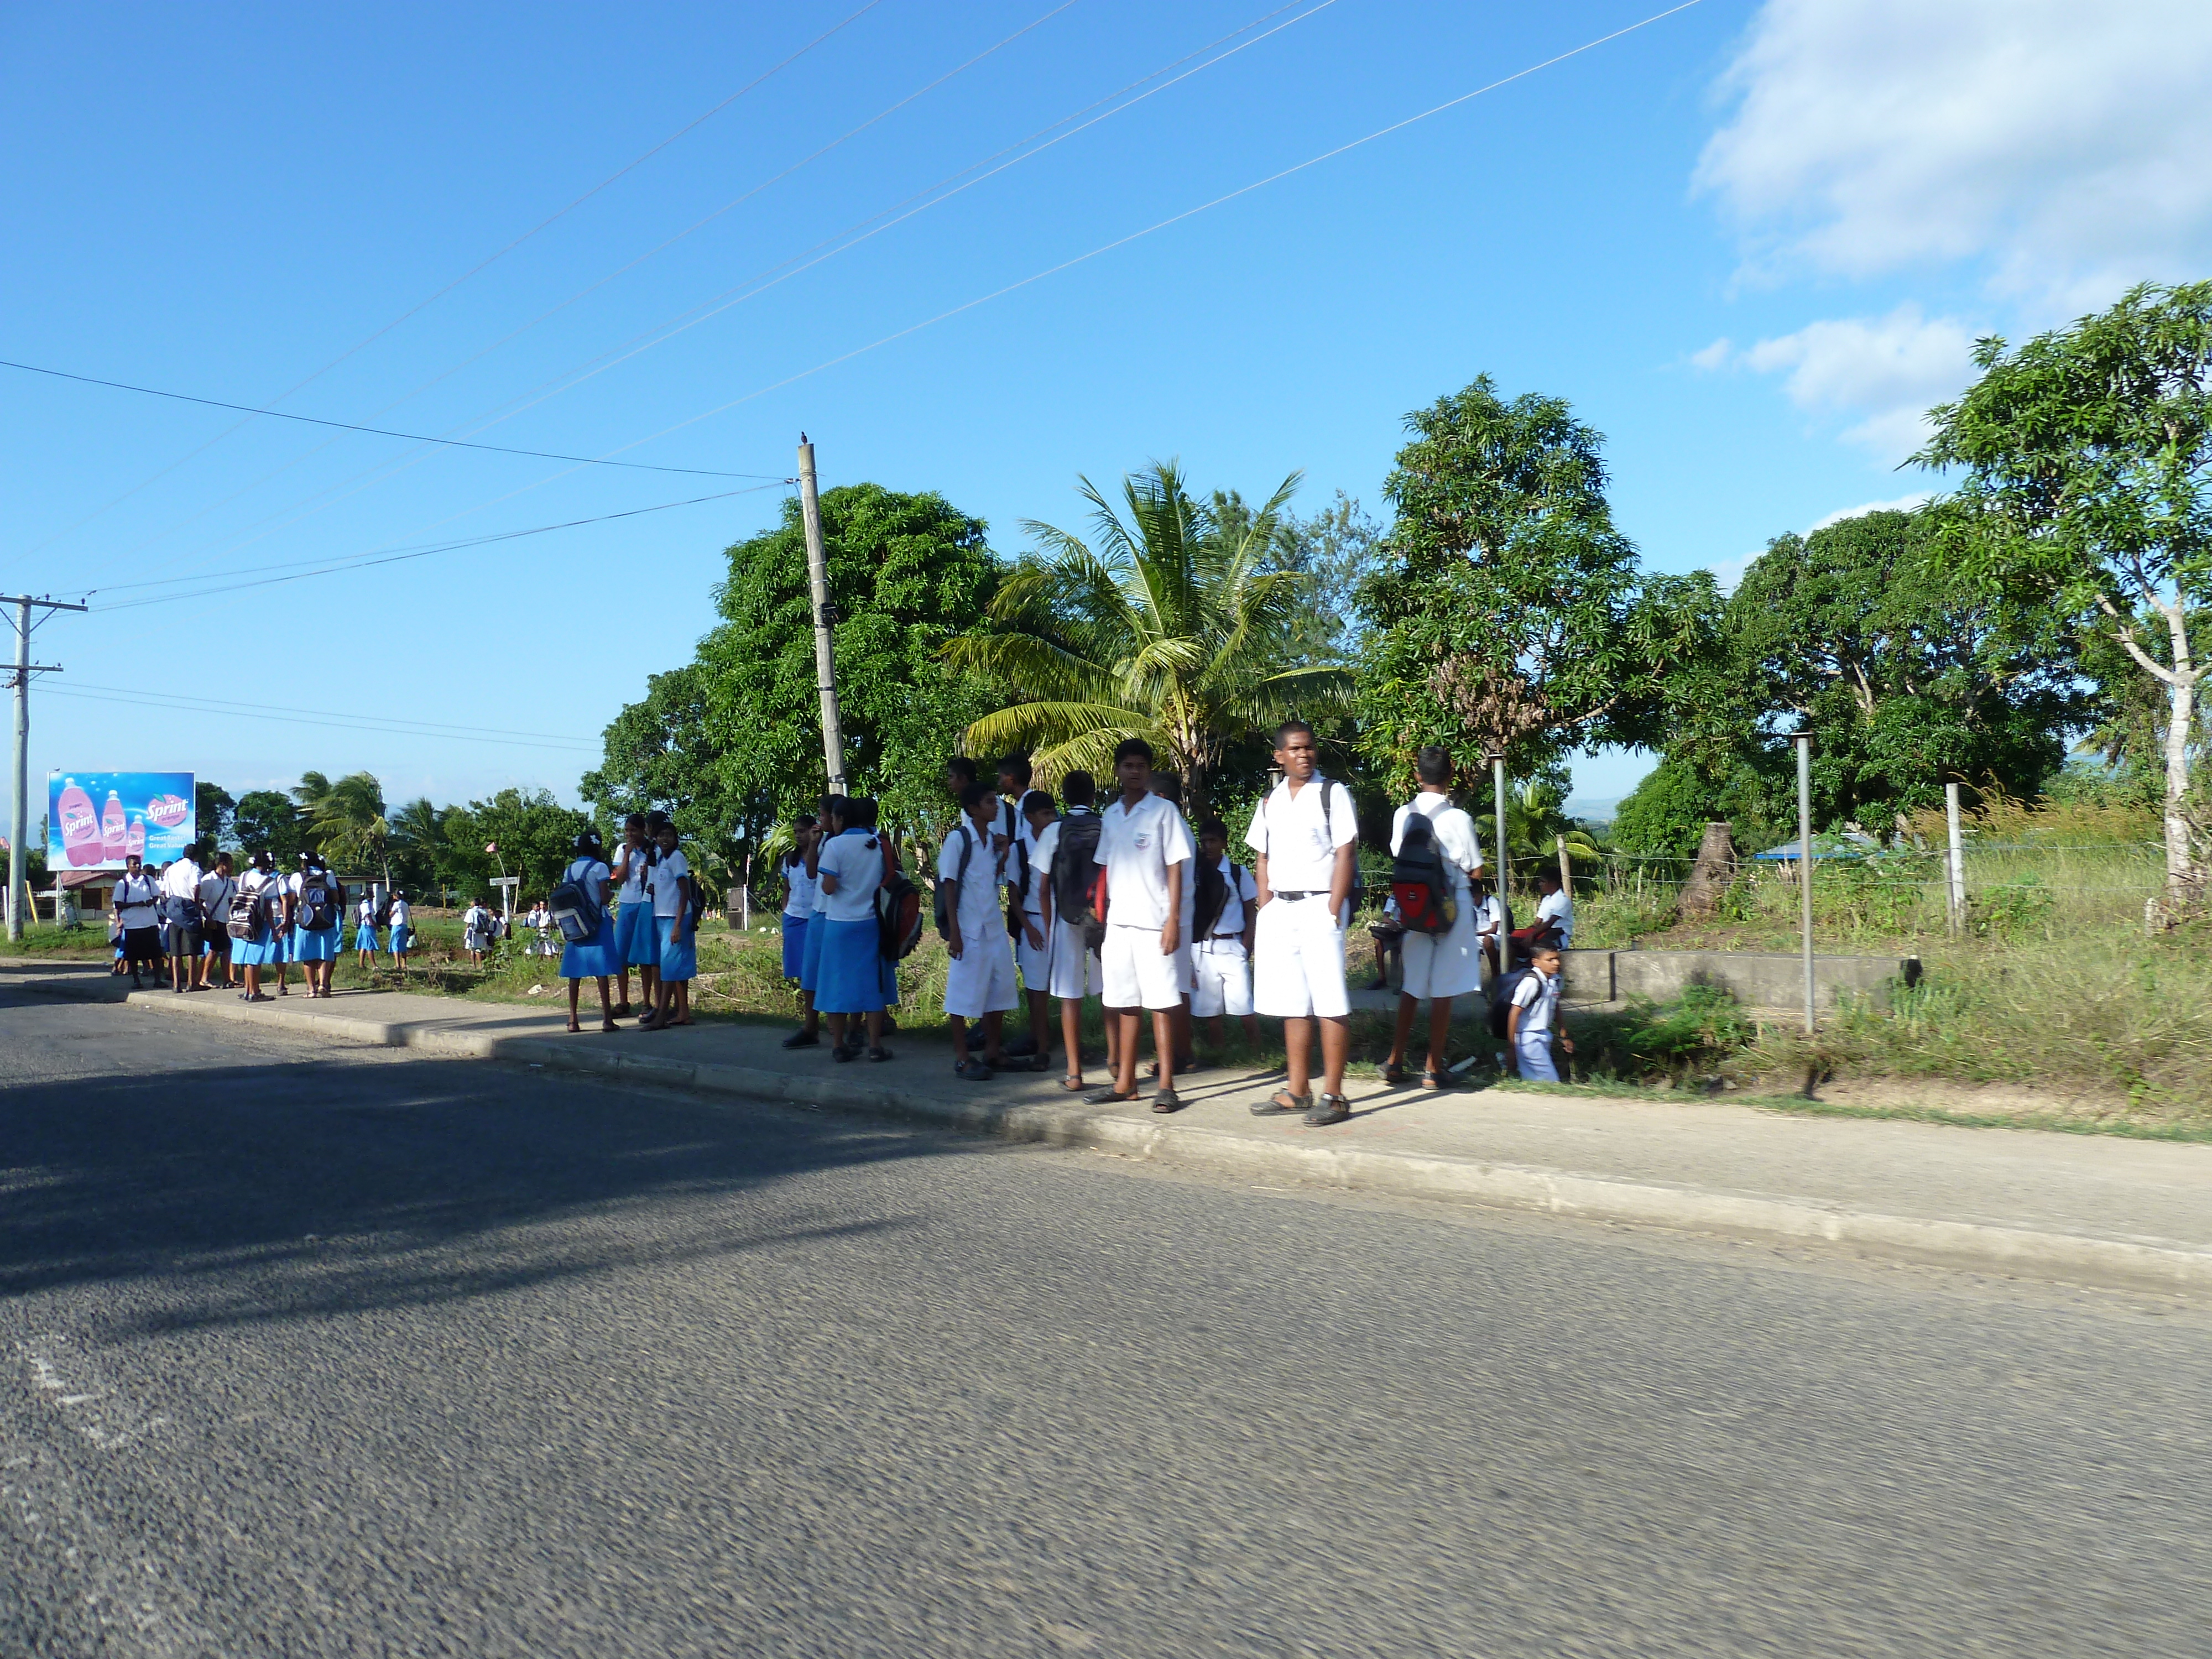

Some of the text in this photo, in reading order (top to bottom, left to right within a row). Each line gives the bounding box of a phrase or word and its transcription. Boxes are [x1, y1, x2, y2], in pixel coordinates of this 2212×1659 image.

[146, 799, 189, 822] Sprint
[65, 814, 93, 837] Sprint
[103, 822, 125, 837] Sprint
